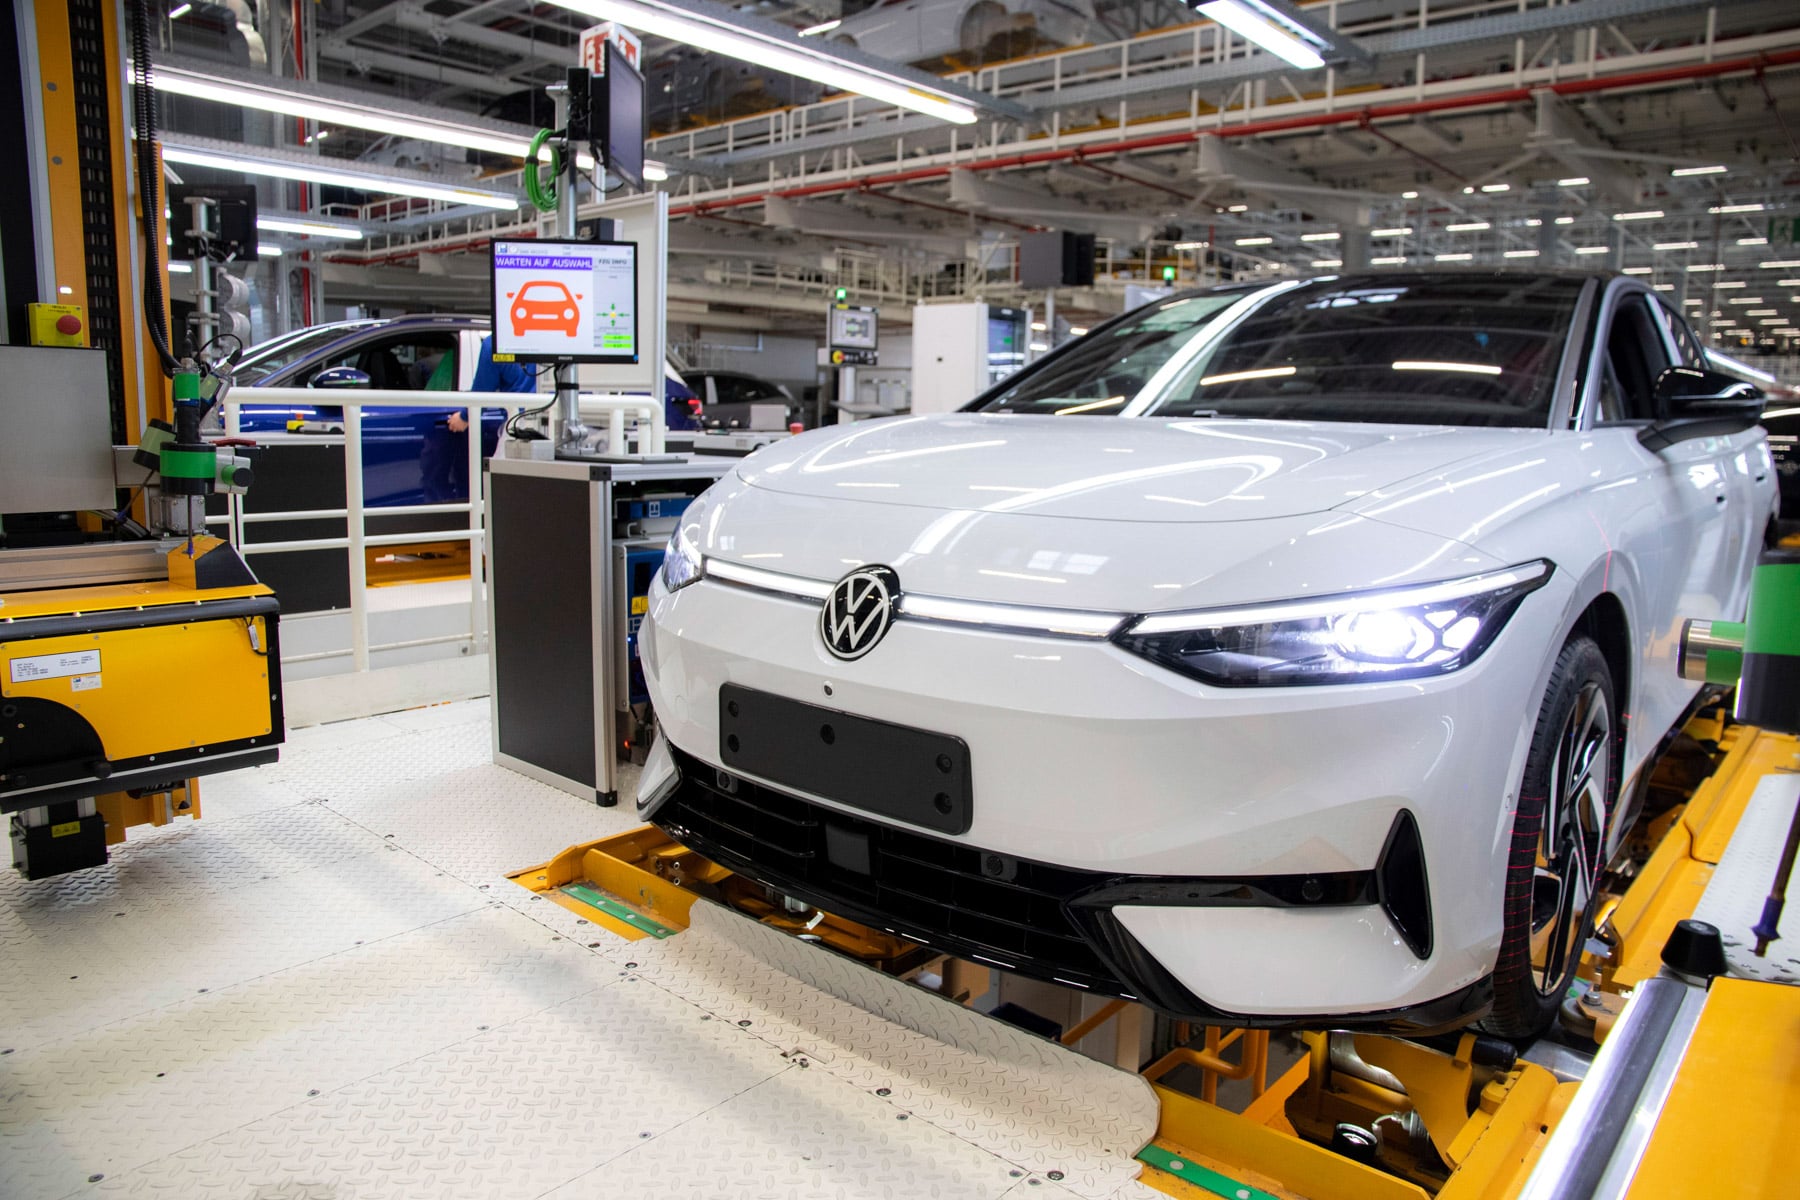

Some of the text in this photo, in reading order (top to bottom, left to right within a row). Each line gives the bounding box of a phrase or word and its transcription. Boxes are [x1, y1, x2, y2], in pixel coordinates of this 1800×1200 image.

[496, 257, 592, 268] WARTEN AUF AUSWAHL
[824, 575, 887, 656] VW
